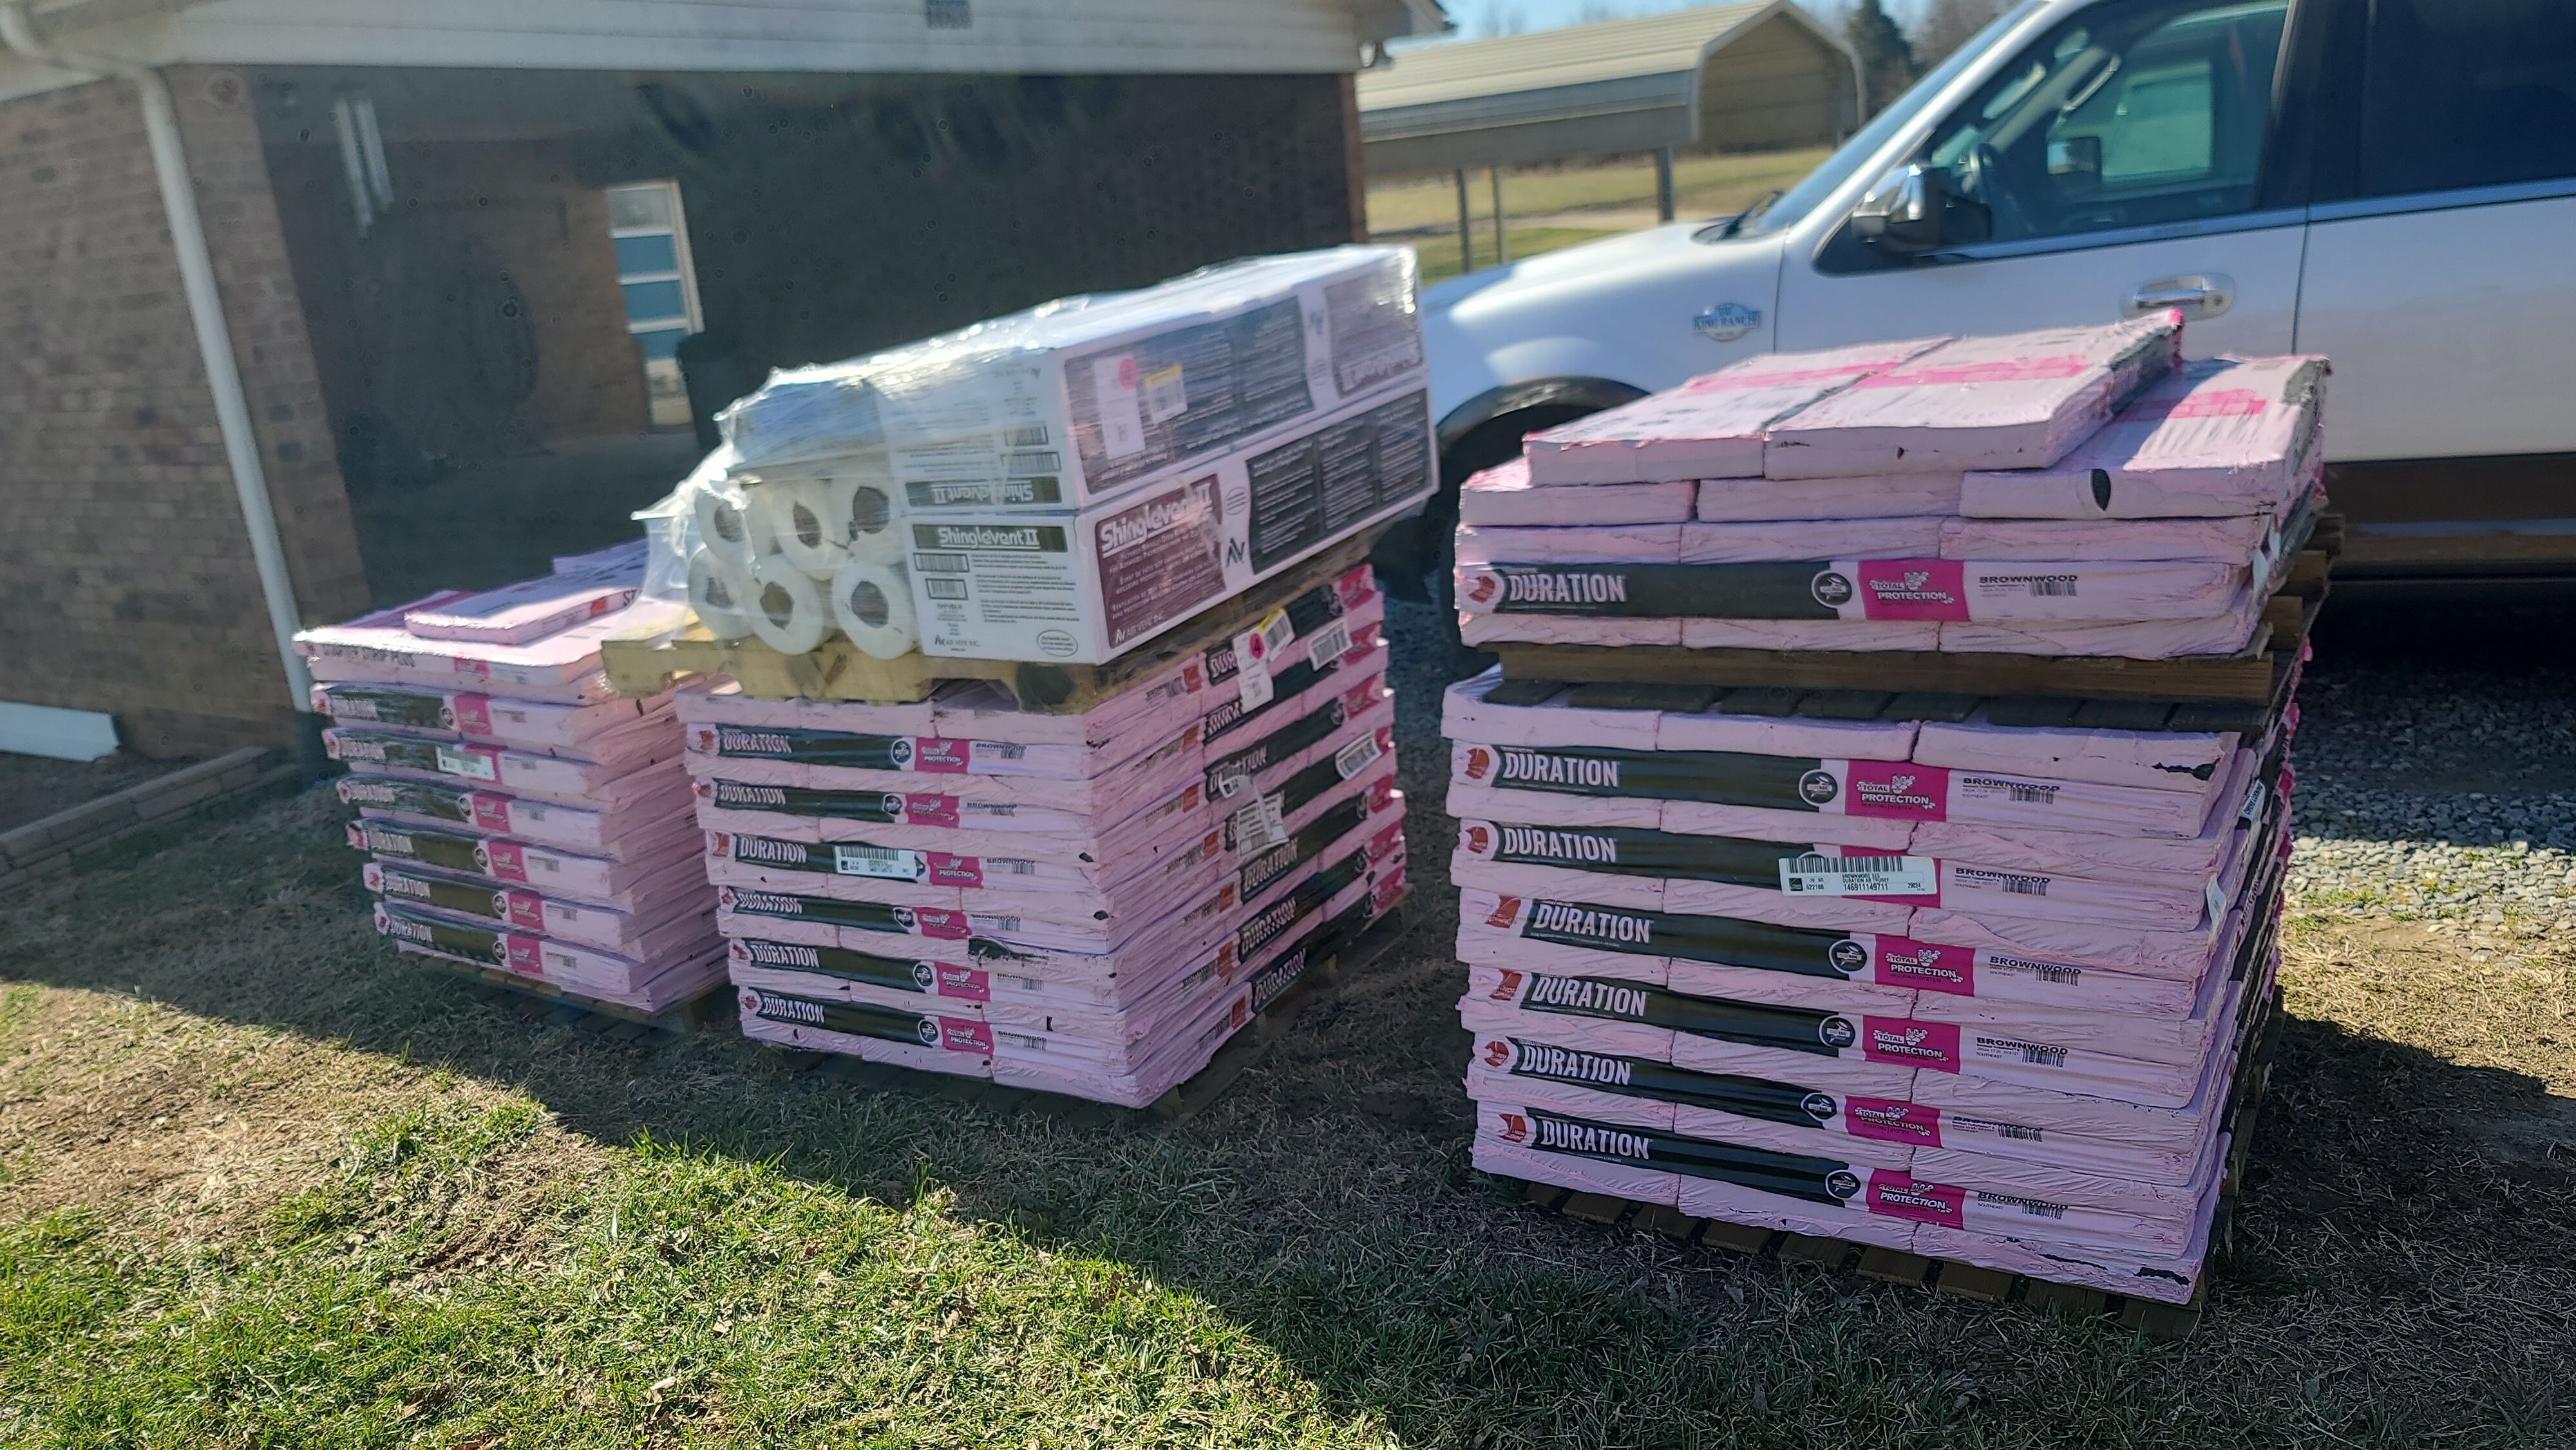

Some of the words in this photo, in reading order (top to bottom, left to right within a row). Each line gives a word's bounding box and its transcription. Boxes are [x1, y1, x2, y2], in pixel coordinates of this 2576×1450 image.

[1508, 574, 1627, 603] DURATION
[1980, 575, 2078, 583] BROWNWOOD
[723, 733, 791, 753] DURATION
[1502, 753, 1619, 787] DURATION
[1963, 778, 2061, 791] BROWNWOOD
[1862, 793, 1929, 804] PROTECTION
[740, 836, 808, 863] DURATION
[1503, 828, 1616, 863] DURATION
[1955, 867, 2051, 883] BROWNWOOD
[1844, 883, 1888, 891] 146911149711
[1532, 903, 1652, 944] DURATION
[750, 944, 820, 968] DURATION
[1989, 956, 2081, 974] BROWNWOOD
[1891, 964, 1956, 978] PROTECTION
[1530, 976, 1648, 1017] DURATION
[762, 997, 825, 1023] DURATION
[1879, 1034, 1903, 1042] TOTAL
[1976, 1037, 2069, 1055] BROWNWOOD
[1877, 1043, 1943, 1057] PROTECTION
[1520, 1044, 1631, 1086] DURATION
[1539, 1119, 1650, 1160] DURATION
[1880, 1192, 1946, 1209] PROTECTION
